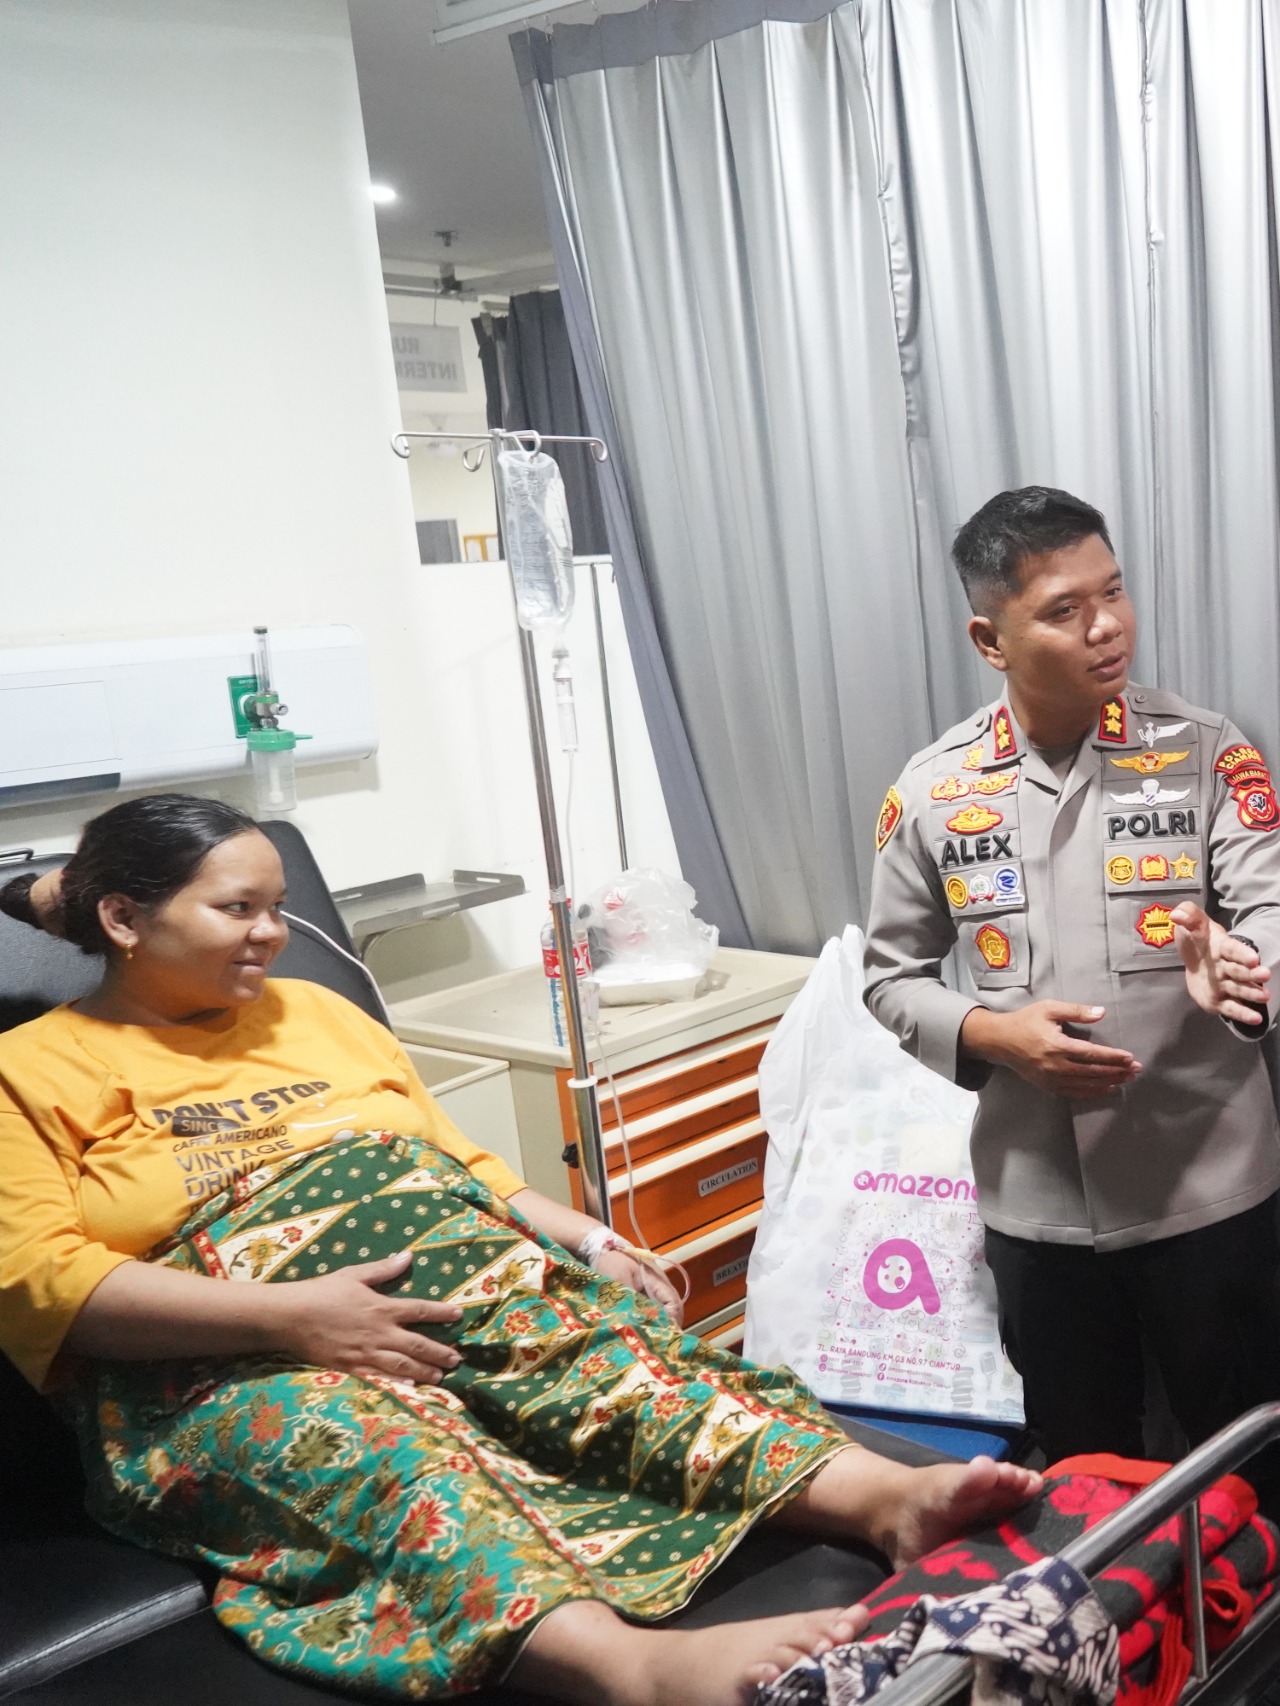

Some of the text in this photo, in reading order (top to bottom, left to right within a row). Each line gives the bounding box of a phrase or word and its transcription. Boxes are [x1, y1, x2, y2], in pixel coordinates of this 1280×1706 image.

[1107, 809, 1195, 839] POLRI
[941, 832, 1013, 868] ALEX
[152, 1099, 251, 1125] DON'T
[215, 1125, 288, 1145] AMERICANO
[176, 1139, 295, 1172] VINTAGE
[700, 1161, 757, 1192] CIRCULATION
[830, 1346, 846, 1354] RAYA
[848, 1349, 881, 1360] BANDUNG
[929, 1360, 961, 1372] CIANJUR
